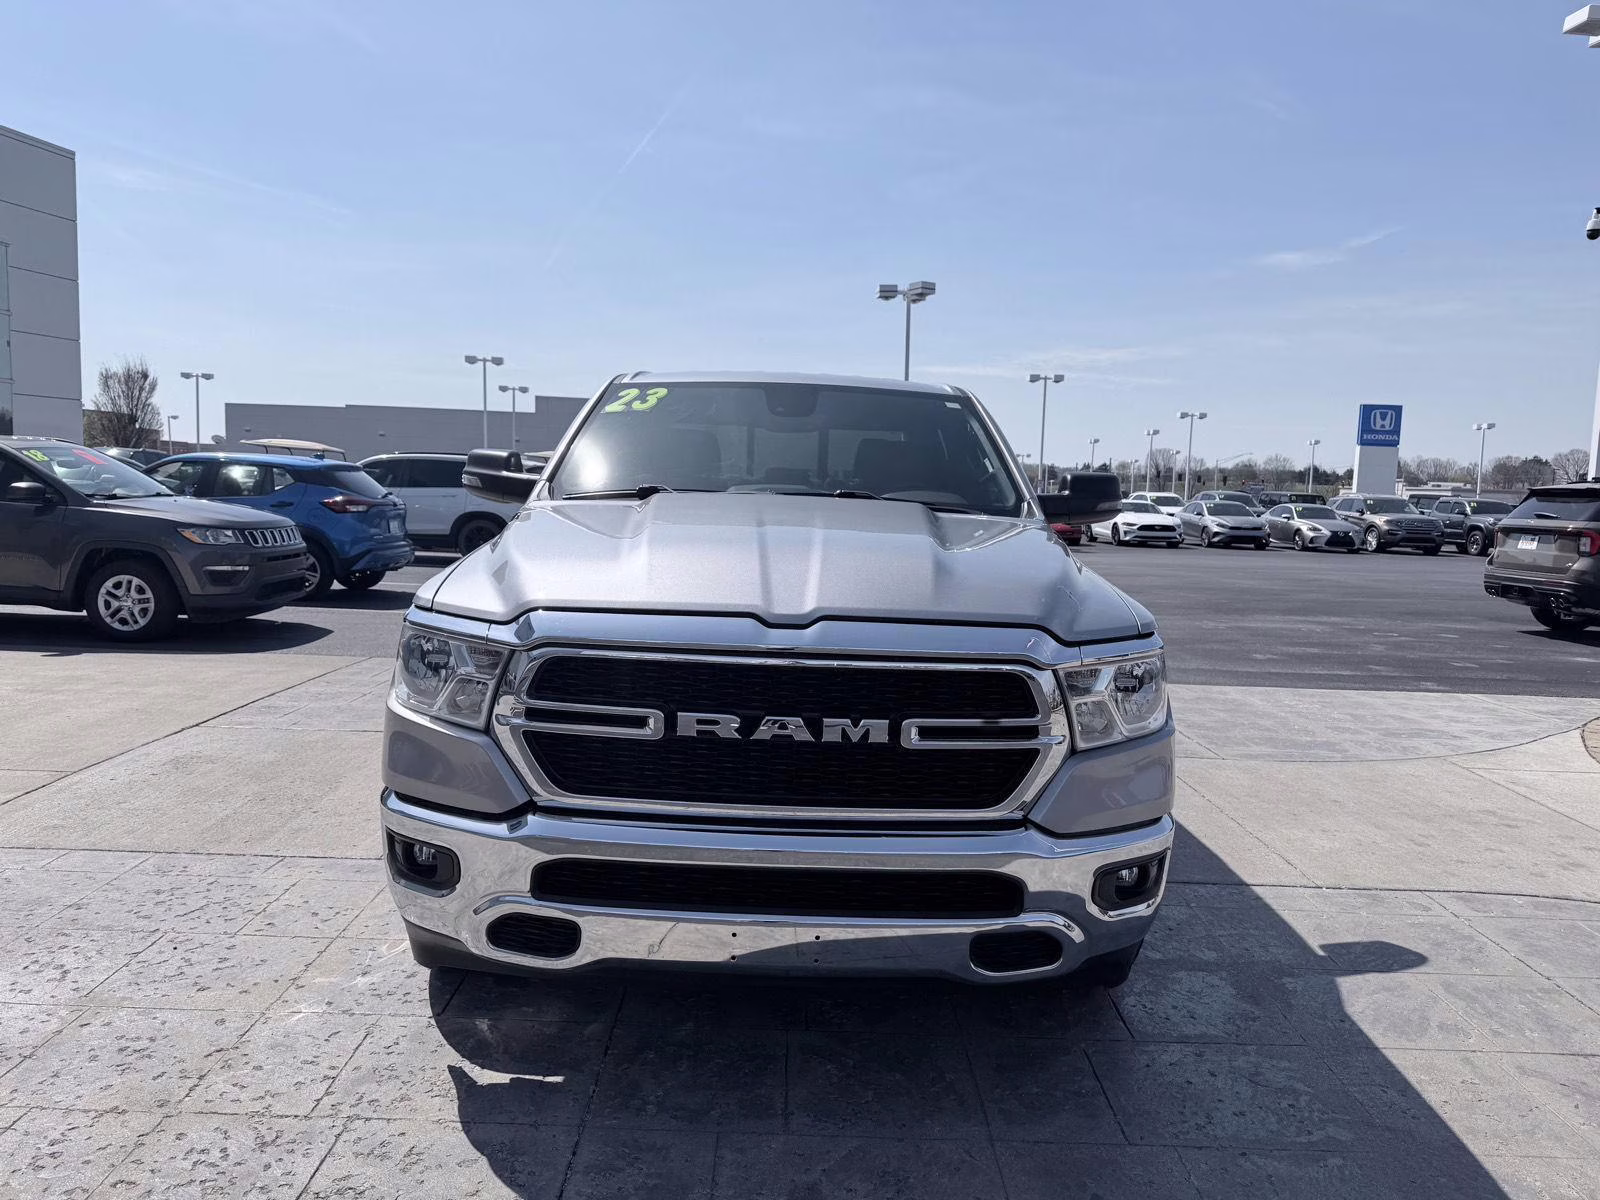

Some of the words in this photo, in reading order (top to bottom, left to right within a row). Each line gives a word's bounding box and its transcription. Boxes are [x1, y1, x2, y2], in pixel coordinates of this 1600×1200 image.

[602, 387, 669, 413] 23
[1363, 433, 1399, 441] HONDA
[677, 711, 889, 743] RAM
